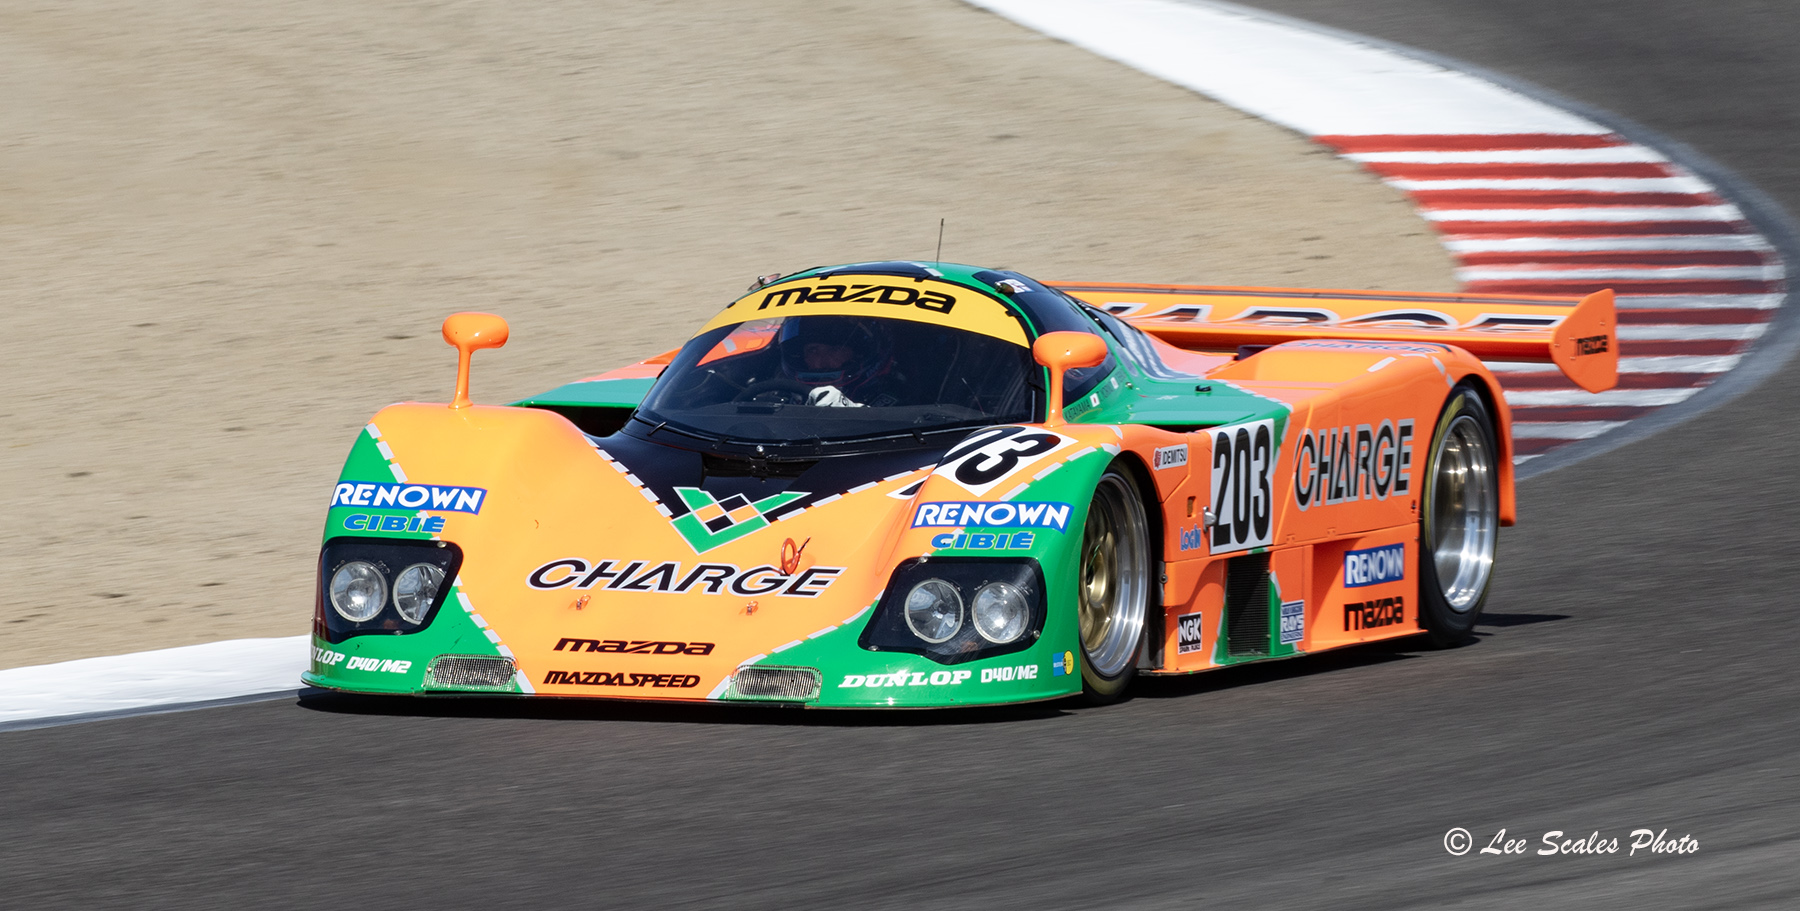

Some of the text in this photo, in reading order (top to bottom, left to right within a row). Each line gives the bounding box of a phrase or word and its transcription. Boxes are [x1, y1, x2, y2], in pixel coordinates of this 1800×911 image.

[757, 284, 957, 315] mazda
[1162, 446, 1188, 466] IDEMITSU
[1293, 418, 1415, 512] CHARGE
[331, 483, 482, 512] RENOWN
[1212, 424, 1271, 547] 203
[343, 514, 447, 533] CIBIÉ
[914, 503, 1070, 530] RENOWN
[931, 531, 1036, 550] CIBIÉ
[525, 557, 847, 599] CHARGE
[1346, 548, 1404, 585] RENOWN
[1179, 618, 1201, 643] NGK
[553, 638, 715, 656] mazda
[346, 656, 412, 674] D40/M2
[838, 664, 1039, 688] DUNLOP D40/M2
[543, 670, 701, 688] MAZDASPEED
